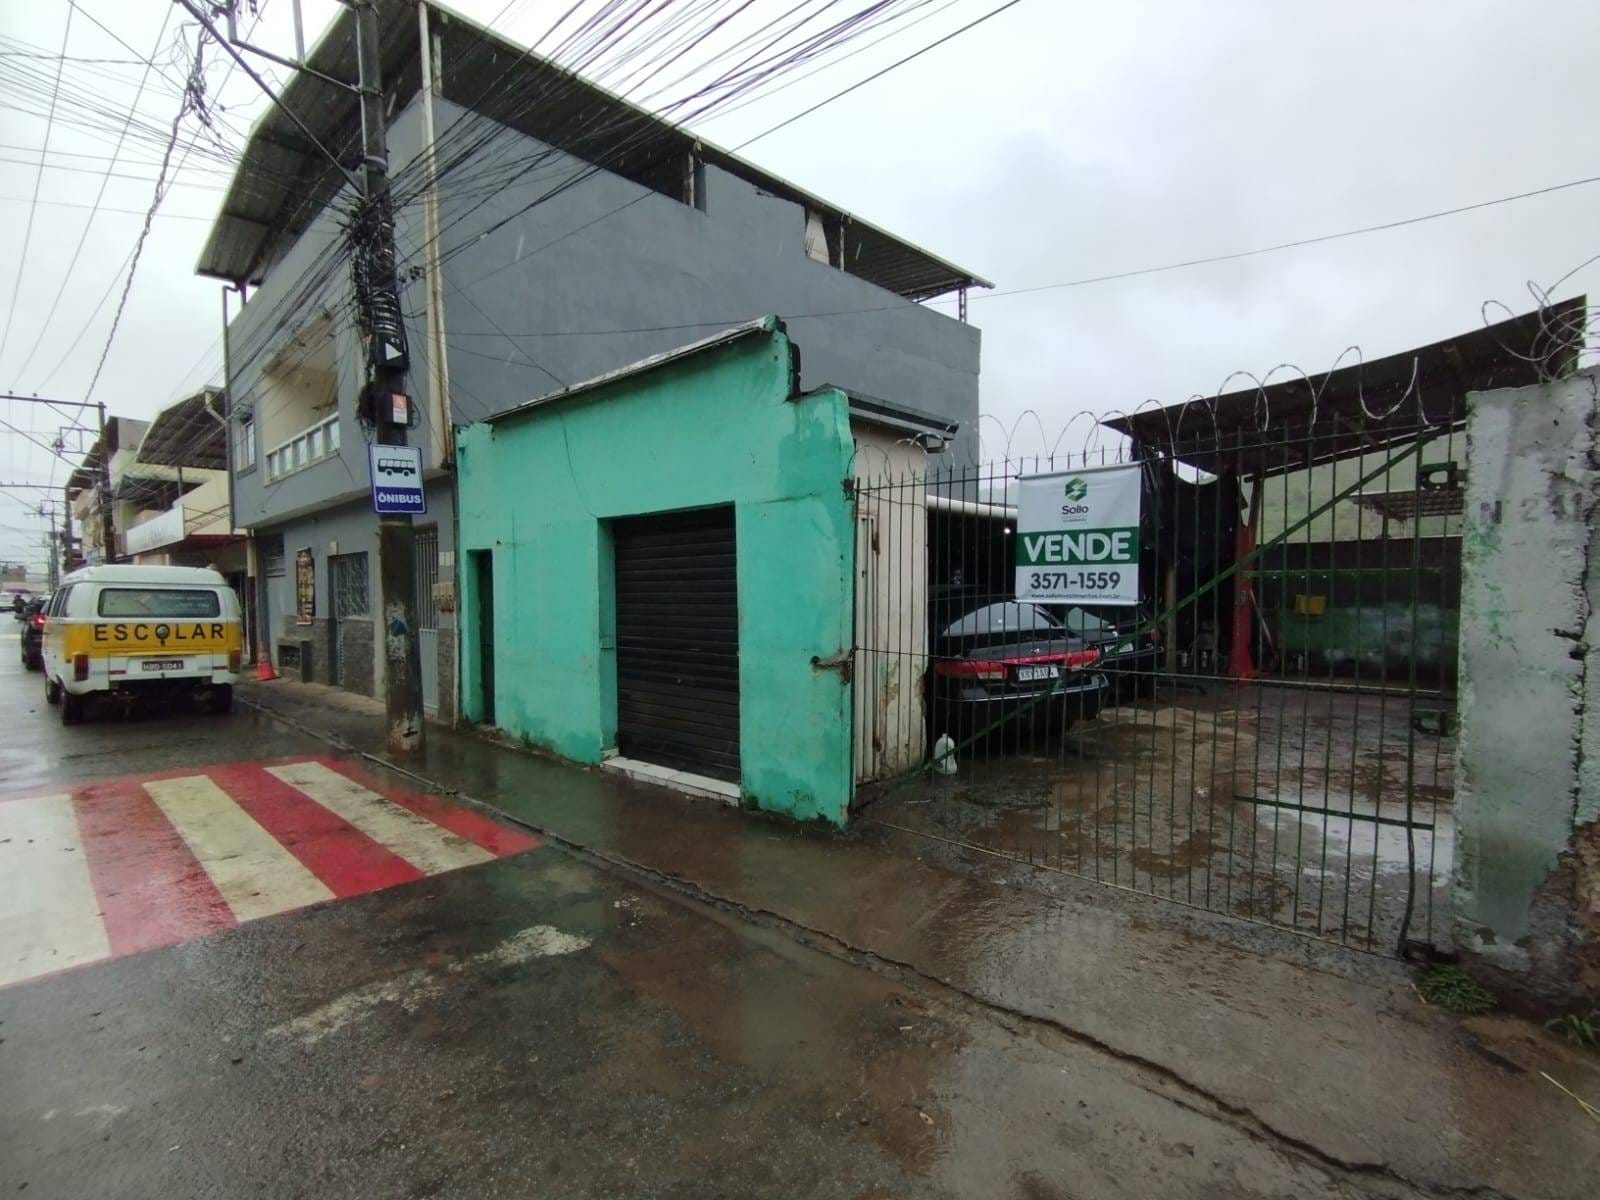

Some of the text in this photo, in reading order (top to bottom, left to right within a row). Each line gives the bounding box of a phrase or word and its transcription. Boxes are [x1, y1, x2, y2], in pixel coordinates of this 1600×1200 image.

[378, 491, 421, 504] ÔNIBUS
[1062, 505, 1089, 514] Sollo
[1024, 531, 1131, 562] VENDE
[1030, 571, 1121, 590] 3571-1559
[94, 623, 225, 641] ESCOLAR
